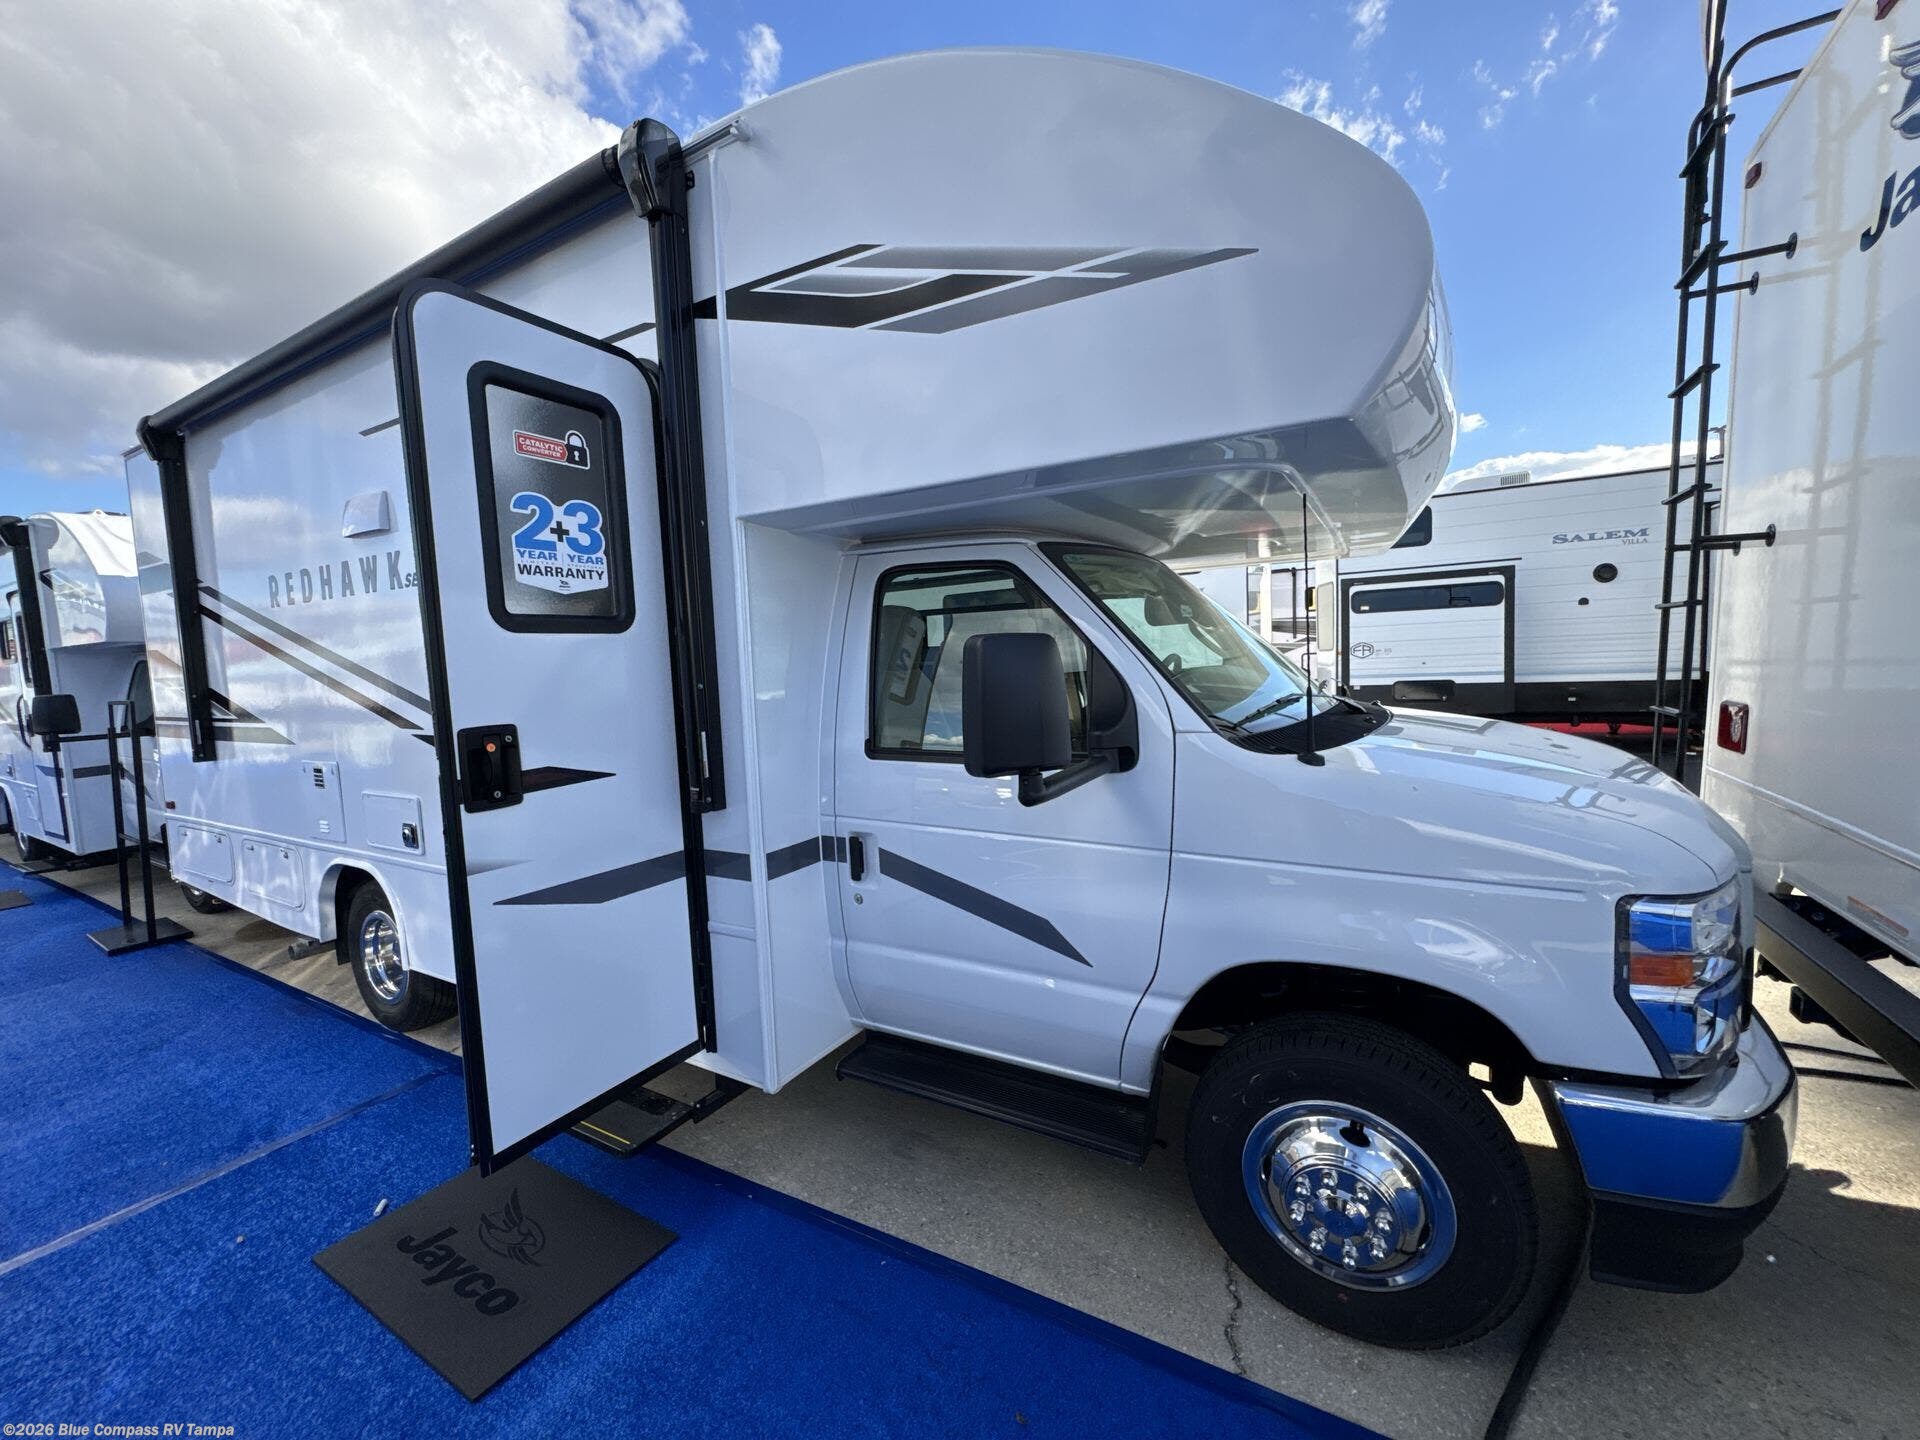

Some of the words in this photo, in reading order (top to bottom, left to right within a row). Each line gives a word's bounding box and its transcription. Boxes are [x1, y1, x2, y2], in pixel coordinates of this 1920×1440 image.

[519, 437, 564, 454] CATALYTIC
[522, 444, 562, 458] CONVERTER
[1552, 527, 1650, 545] SALEM
[1621, 538, 1648, 546] VILLA
[516, 549, 558, 561] YEAR
[567, 554, 605, 565] YEAR
[268, 550, 404, 609] REDHAWK
[517, 563, 605, 580] WARRANTY
[1352, 643, 1373, 657] FR
[396, 1226, 520, 1316] Jayco
